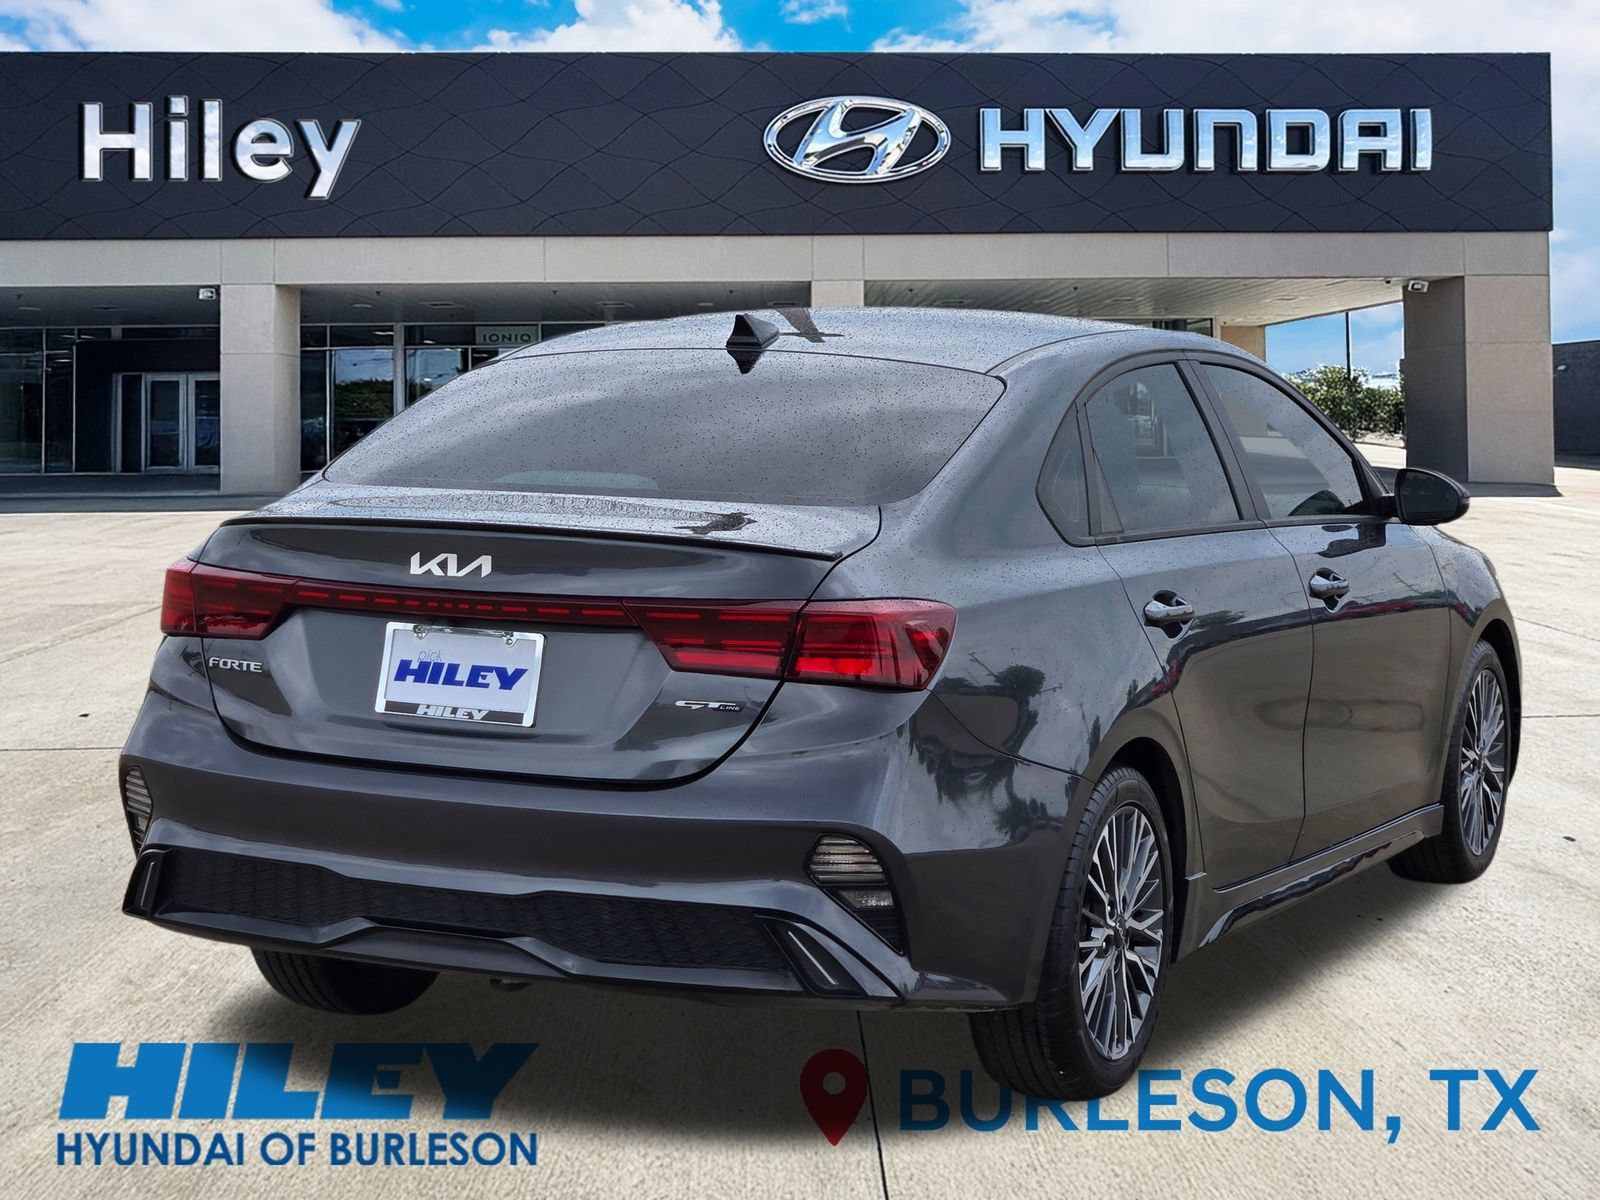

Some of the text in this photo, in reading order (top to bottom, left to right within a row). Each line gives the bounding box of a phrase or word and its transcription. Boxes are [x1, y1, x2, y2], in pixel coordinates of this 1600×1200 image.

[80, 96, 361, 199] Hiley
[979, 107, 1432, 172] HYUNDAI
[410, 552, 492, 578] KIA
[208, 657, 262, 673] FORTE
[417, 649, 442, 664] pick
[394, 659, 529, 691] HILEY
[416, 704, 490, 720] HILEY
